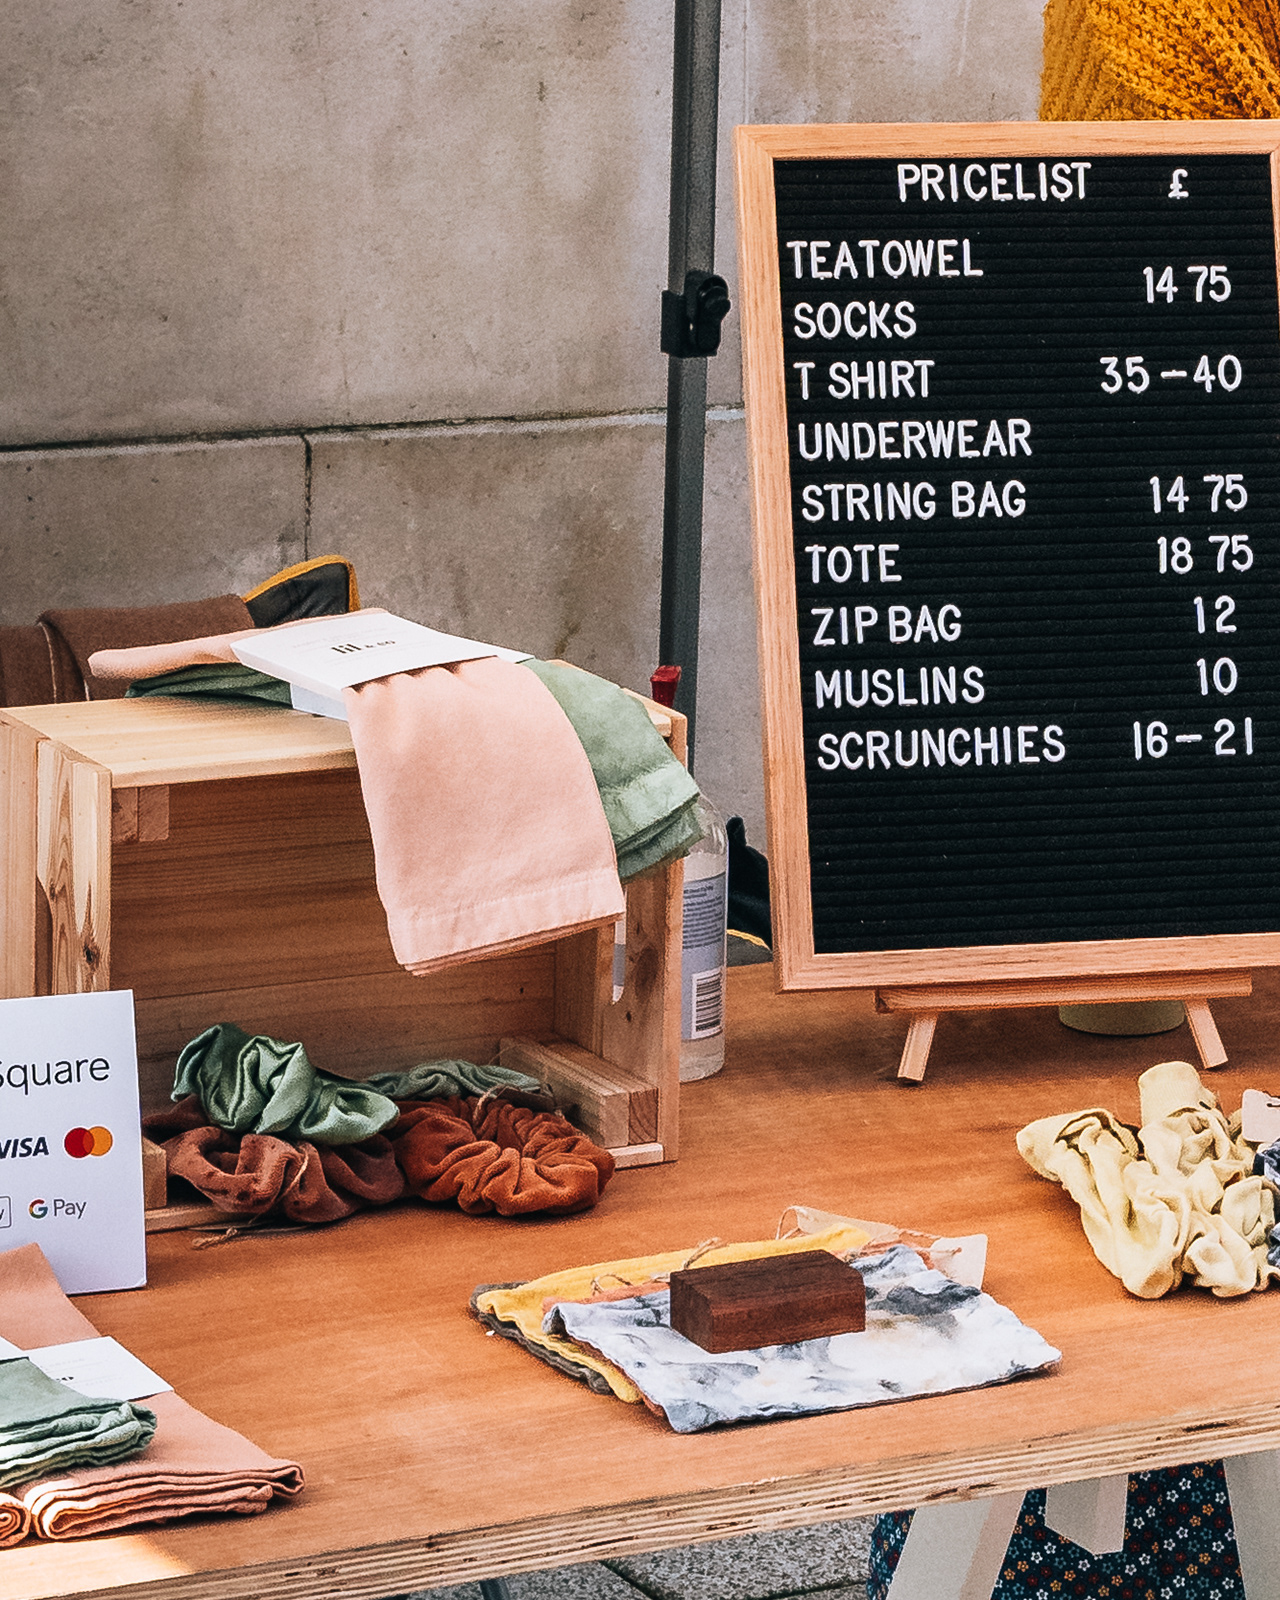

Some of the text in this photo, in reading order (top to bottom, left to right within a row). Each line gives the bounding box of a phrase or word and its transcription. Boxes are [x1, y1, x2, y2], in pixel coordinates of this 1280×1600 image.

[898, 162, 1189, 202] PRICELIST £
[787, 239, 984, 280] TEATOWEL
[1143, 266, 1232, 304] 14 75
[793, 301, 917, 340] SOCKS
[793, 362, 816, 401] T
[827, 360, 936, 400] SHIRT
[798, 419, 1033, 462] UNDERWEAR
[801, 474, 1248, 522] STRING BAG 14 75
[804, 535, 1254, 584] TOTE 18 75
[1193, 595, 1237, 634] 12
[815, 657, 1238, 709] MUSLINS 10
[817, 725, 1066, 772] SCRUNCHIES
[0, 1058, 110, 1095] quare
[0, 1136, 49, 1159] VISA
[53, 1199, 87, 1220] Pay
